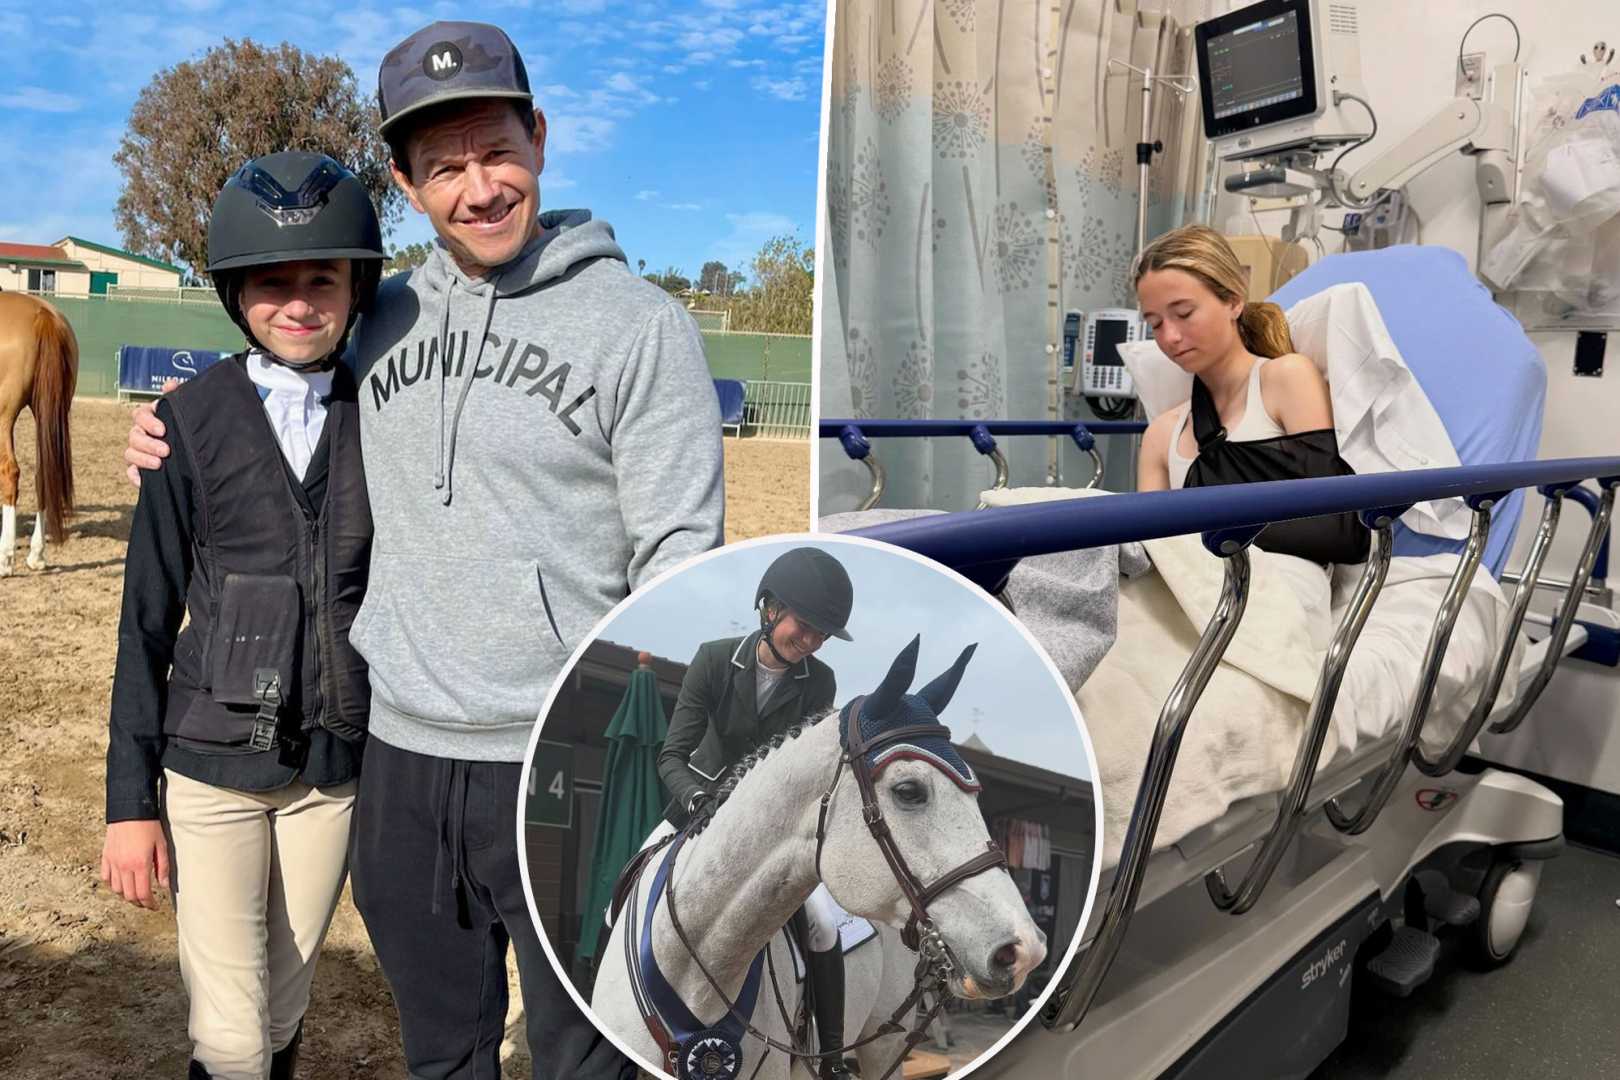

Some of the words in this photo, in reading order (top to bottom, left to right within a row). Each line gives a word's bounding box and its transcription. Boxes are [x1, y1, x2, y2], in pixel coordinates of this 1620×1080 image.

[432, 51, 457, 71] M.
[370, 330, 597, 437] MUNICIPAL
[548, 771, 564, 799] 4
[1301, 939, 1347, 990] stryker
